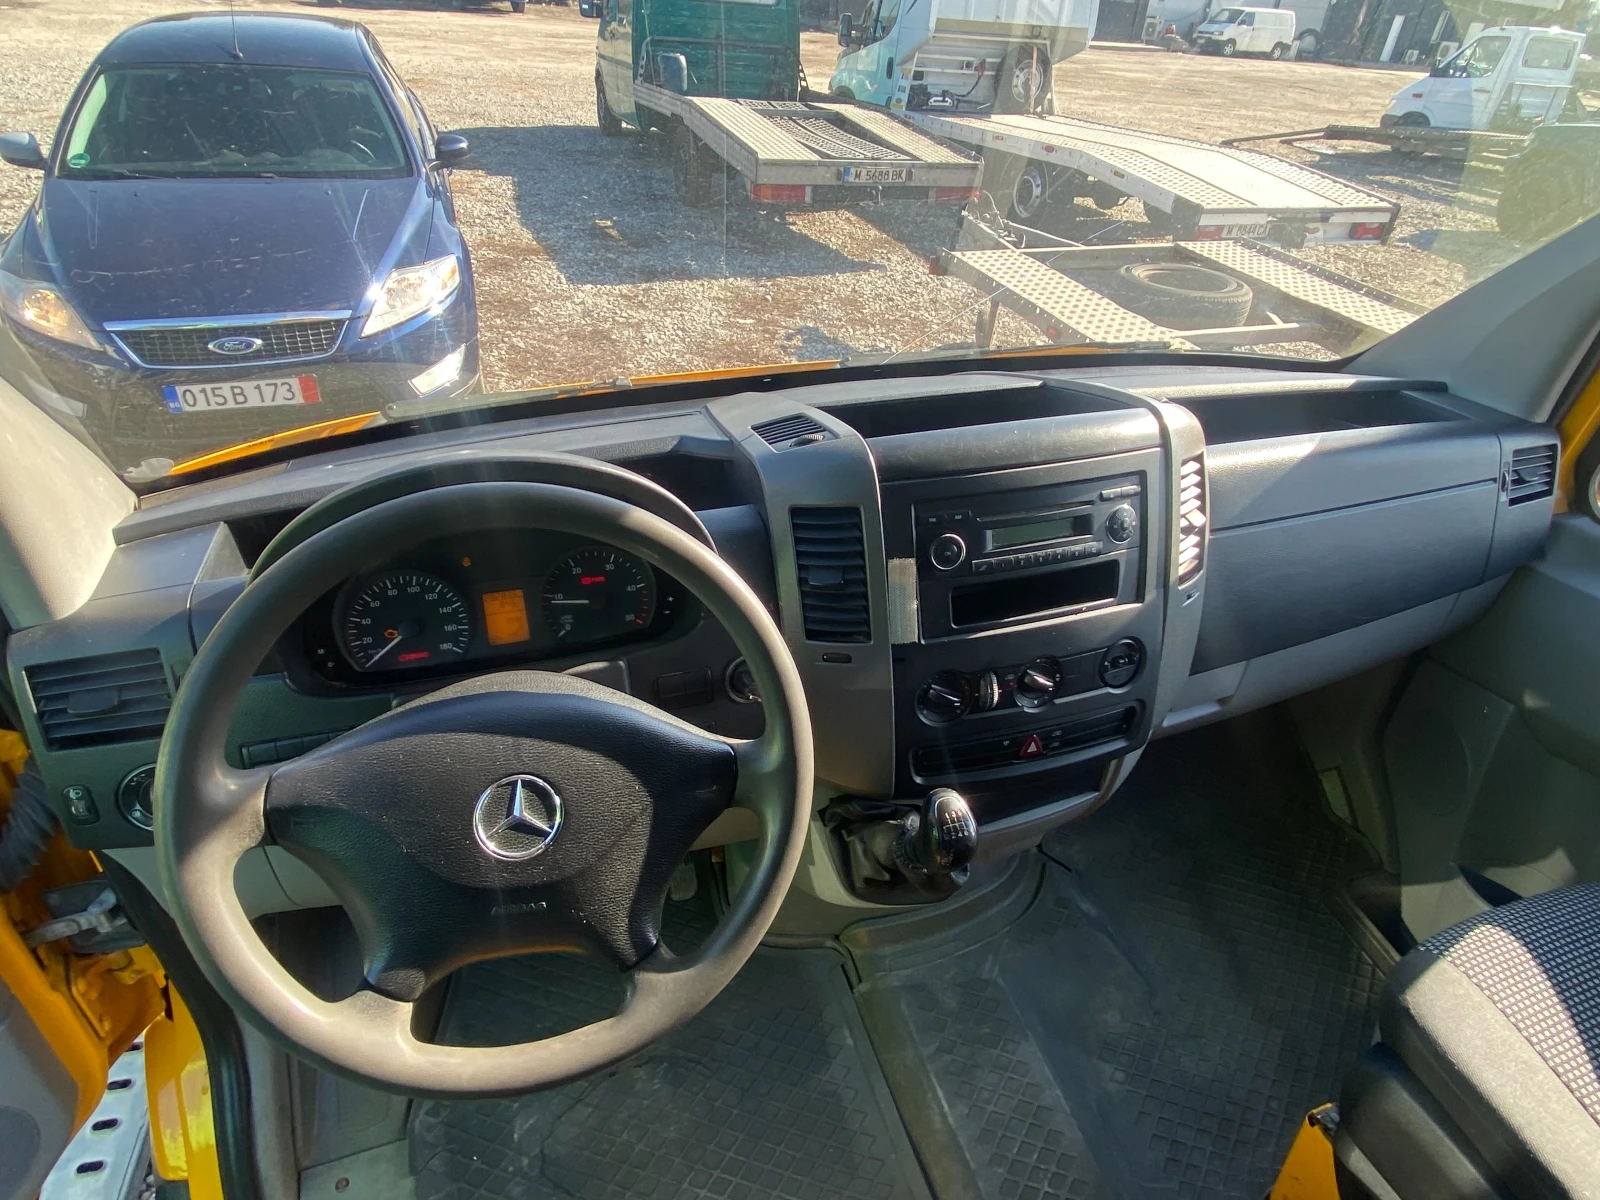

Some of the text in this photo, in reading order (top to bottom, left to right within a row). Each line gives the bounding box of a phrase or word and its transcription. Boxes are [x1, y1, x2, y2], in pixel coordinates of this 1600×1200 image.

[854, 168, 904, 181] M 5688 BK
[223, 341, 246, 351] Ford
[182, 381, 296, 408] 015 B 173
[571, 567, 582, 575] 20
[604, 563, 615, 571] 30
[387, 588, 398, 596] 80
[406, 585, 420, 593] 100
[626, 584, 637, 592] 40
[424, 592, 438, 600] 120
[370, 600, 380, 608] 60
[438, 606, 452, 614] 140
[361, 617, 371, 625] 40
[625, 613, 635, 621] 50
[444, 623, 457, 631] 160
[362, 636, 373, 644] 20
